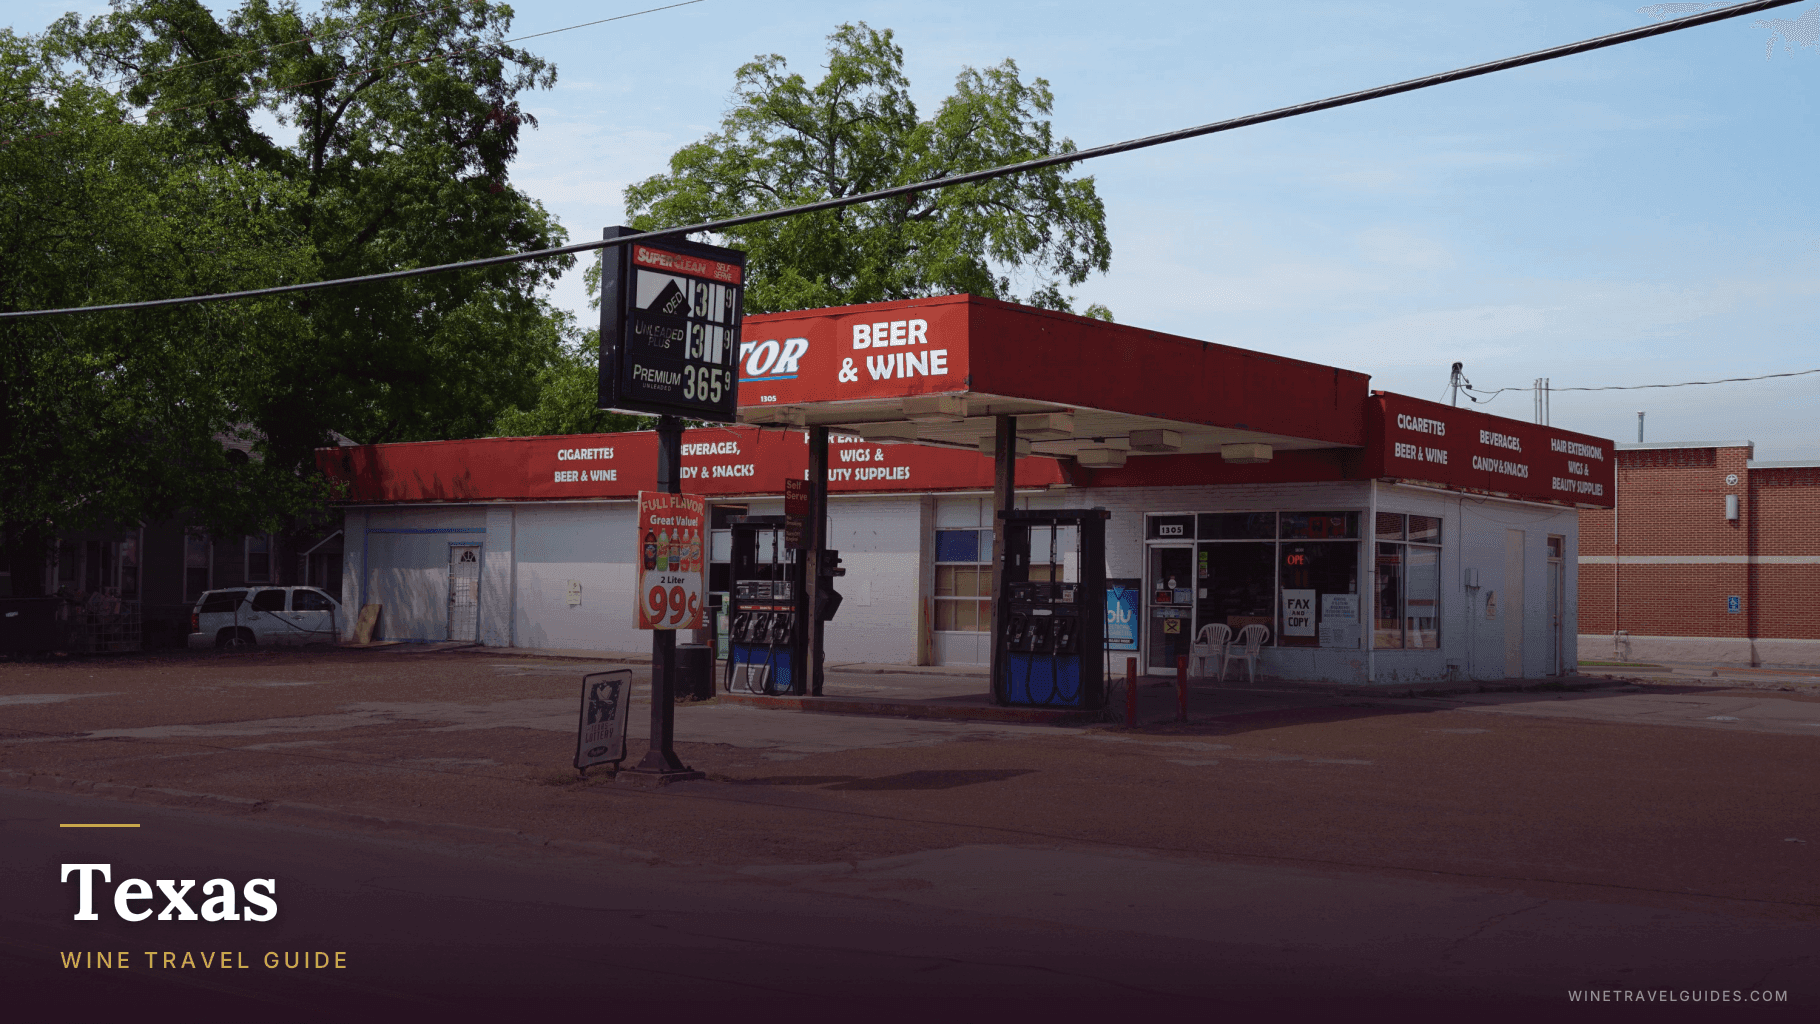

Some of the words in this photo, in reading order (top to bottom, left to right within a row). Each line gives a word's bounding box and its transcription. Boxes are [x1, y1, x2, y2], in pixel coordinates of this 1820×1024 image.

[716, 262, 732, 273] SELF
[713, 270, 733, 282] SERVE
[635, 319, 684, 342] UNLEADED
[853, 319, 928, 350] BEER
[648, 336, 671, 349] PLUS
[838, 357, 858, 383] &
[866, 349, 949, 381] WINE
[633, 364, 681, 386] PREMIUM
[642, 382, 672, 392] UNLEADED
[760, 395, 777, 403] 1305
[1397, 413, 1446, 437] CIGARETTES
[1479, 429, 1522, 453] BEVERAGES,
[557, 447, 615, 461] CIGARETTES
[840, 448, 871, 462] WIGS
[874, 448, 884, 462] &
[1394, 442, 1417, 460] BEER
[1417, 446, 1424, 461] &
[1425, 447, 1448, 465] WINE
[1550, 438, 1567, 453] HAIR
[1567, 441, 1604, 462] EXTENSIONS,
[701, 466, 710, 478] &
[712, 464, 755, 478] SNACKS
[854, 466, 910, 480] SUPPLIES
[1567, 460, 1583, 475] WIGS
[1584, 463, 1590, 476] &
[554, 470, 579, 483] BEER
[580, 470, 588, 482] &
[590, 469, 617, 482] WINE
[786, 480, 802, 490] Self
[1551, 476, 1576, 493] BEAUTY
[1576, 481, 1604, 497] SUPPLIES
[786, 490, 808, 501] Serve
[641, 497, 669, 514] FULL
[649, 514, 674, 526] Great
[675, 516, 699, 527] Value!
[1161, 526, 1182, 534] 1305
[660, 576, 666, 584] 2
[667, 576, 685, 584] Liter
[1287, 599, 1310, 610] FAX
[1288, 617, 1309, 627] COPY
[585, 728, 614, 743] LOTTERY
